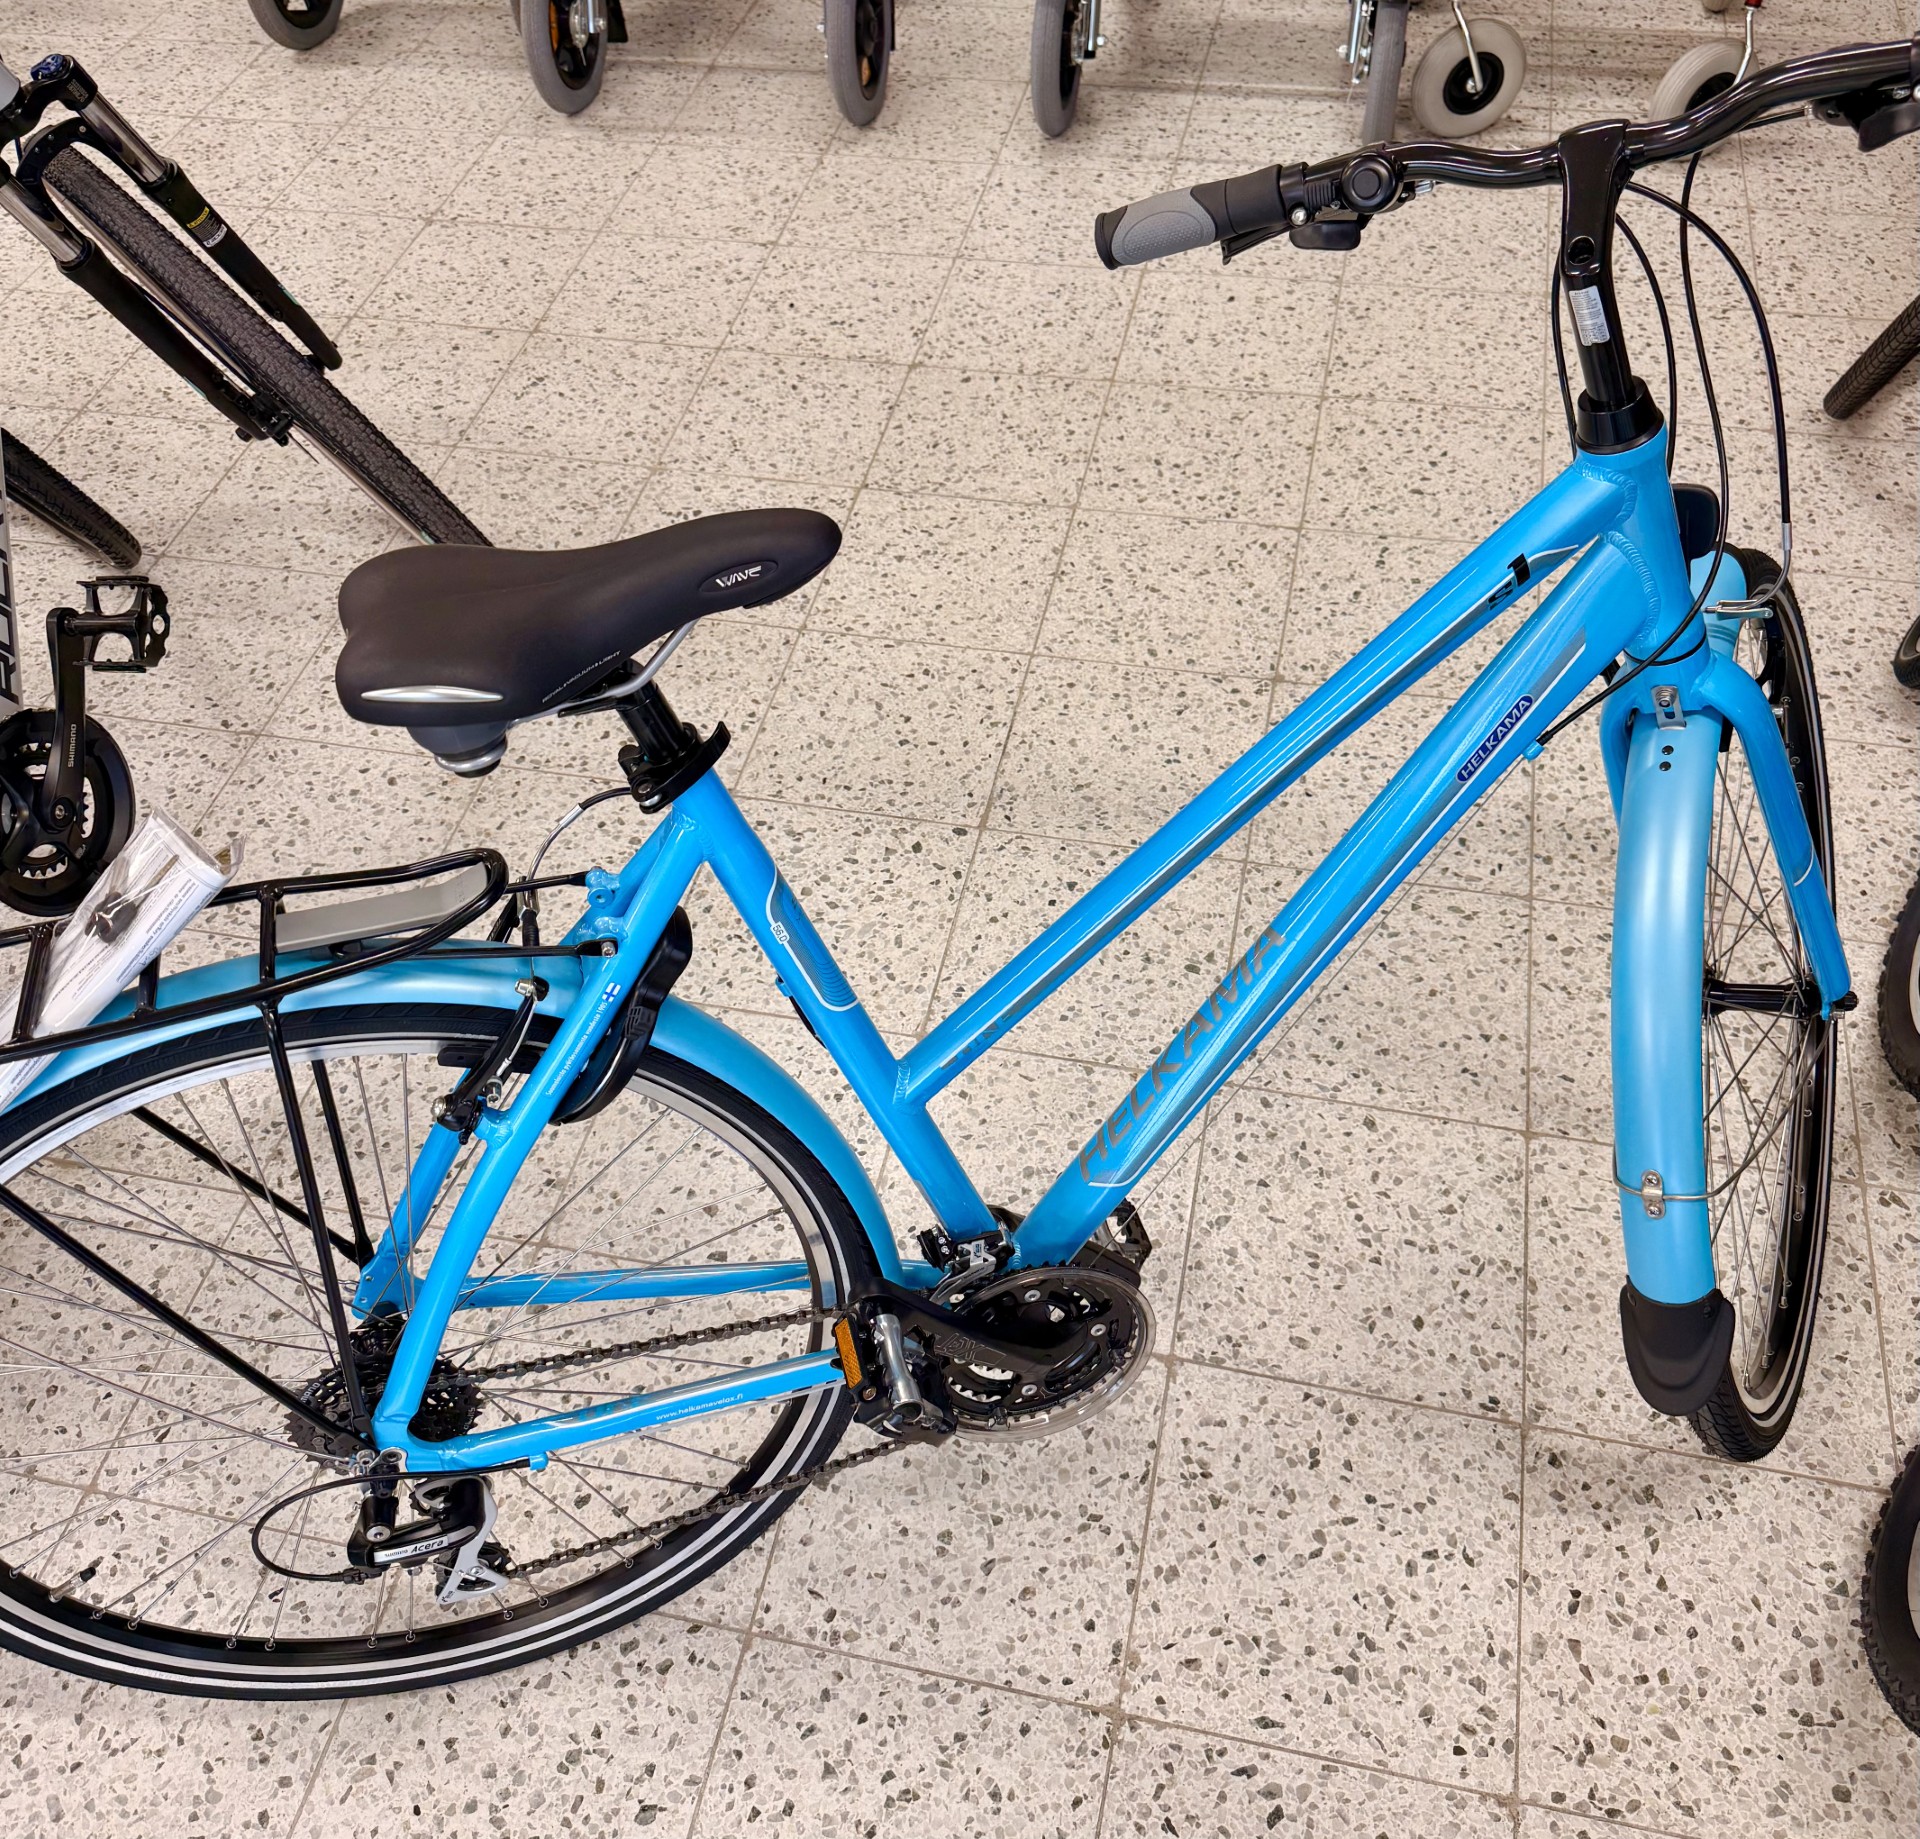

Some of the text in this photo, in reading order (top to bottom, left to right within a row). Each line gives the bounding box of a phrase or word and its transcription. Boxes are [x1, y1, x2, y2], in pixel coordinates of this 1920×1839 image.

[715, 565, 762, 588] WAVE
[67, 723, 77, 768] SHIMANO
[1461, 700, 1531, 779] HELKAMA
[1079, 926, 1286, 1182] HELKAMA
[656, 1392, 744, 1421] www.helkamavelox.fi
[411, 1540, 444, 1554] Acera
